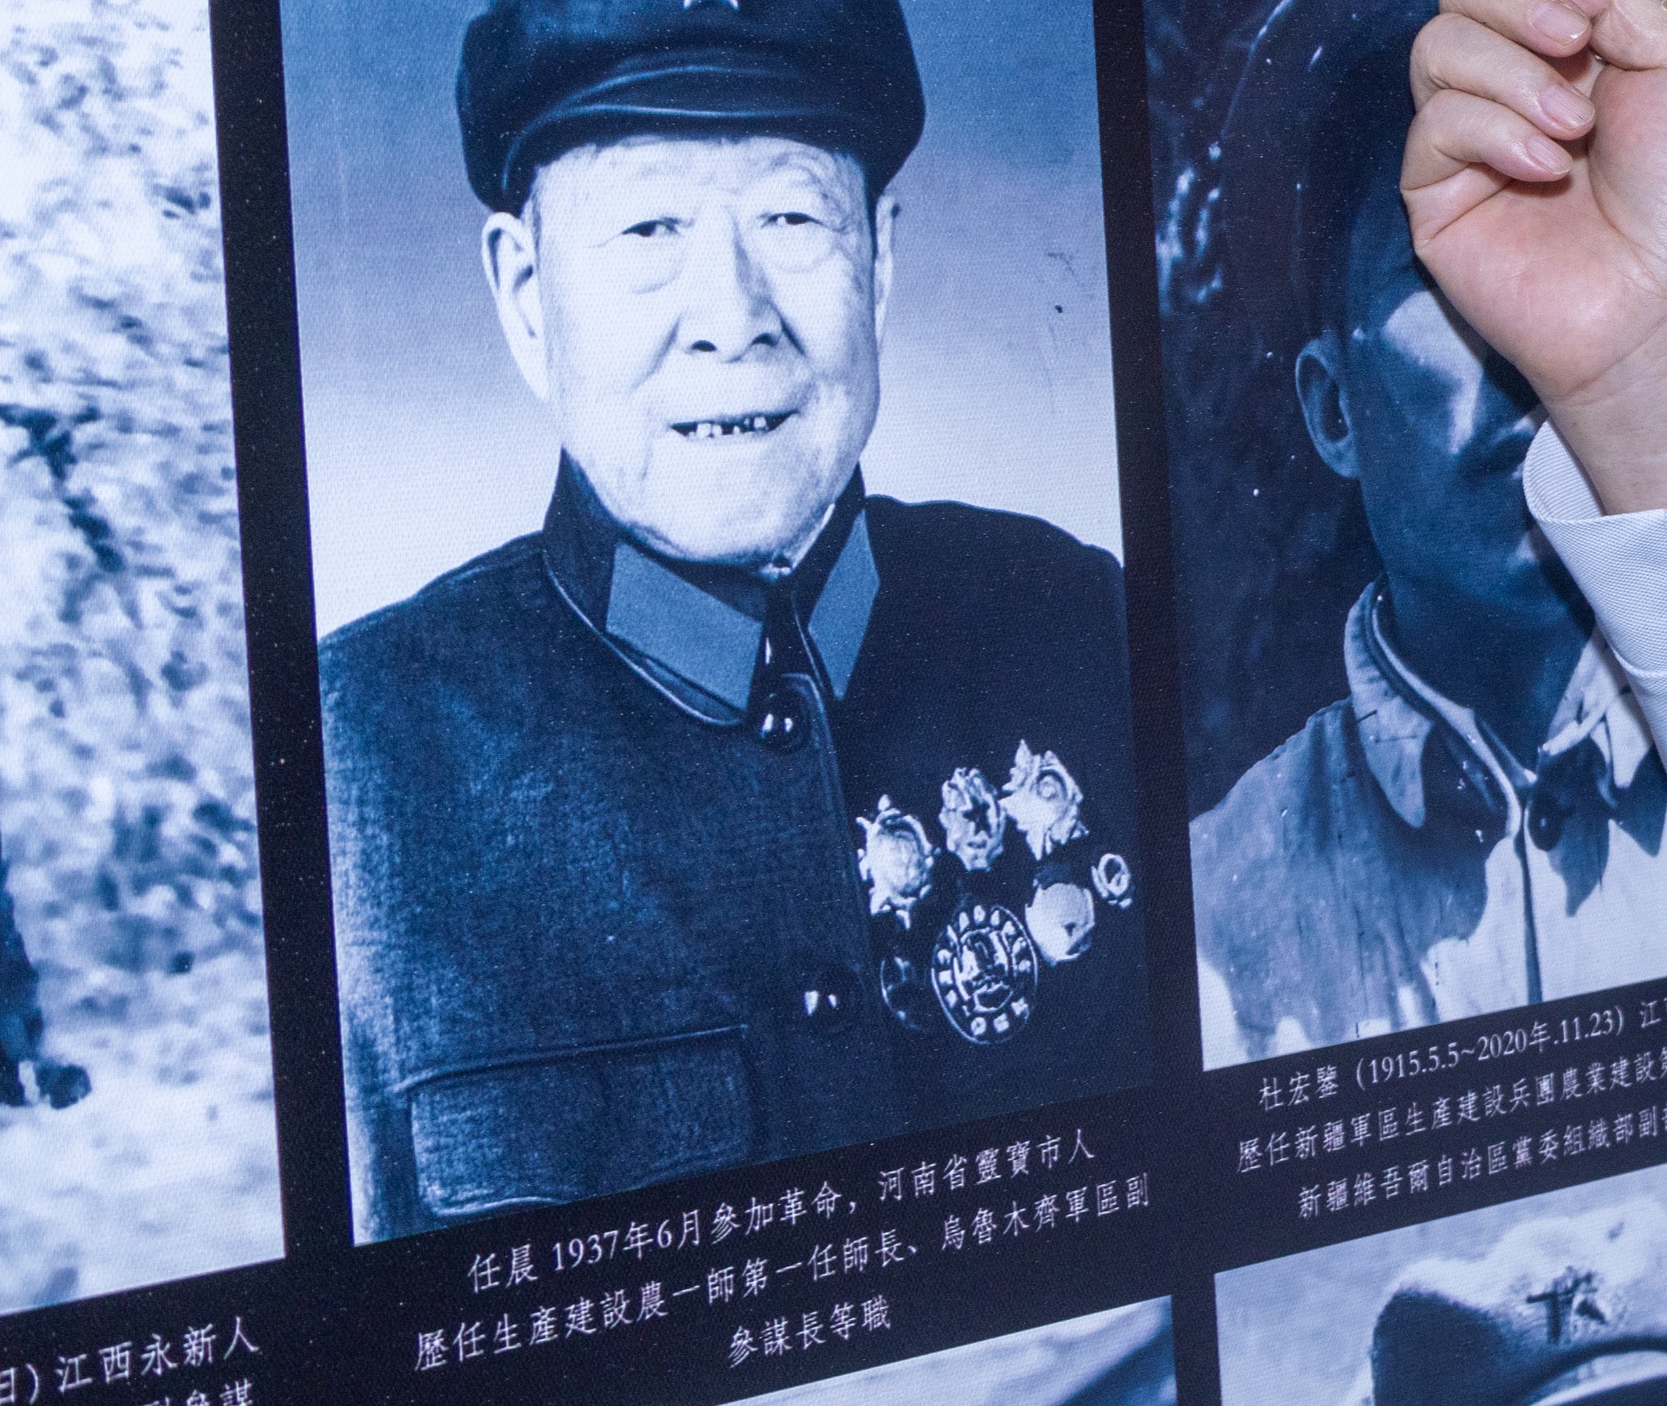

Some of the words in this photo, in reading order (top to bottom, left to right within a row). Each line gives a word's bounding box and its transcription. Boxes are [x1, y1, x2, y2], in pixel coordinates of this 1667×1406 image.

[728, 1294, 893, 1369] 參謀長等職
